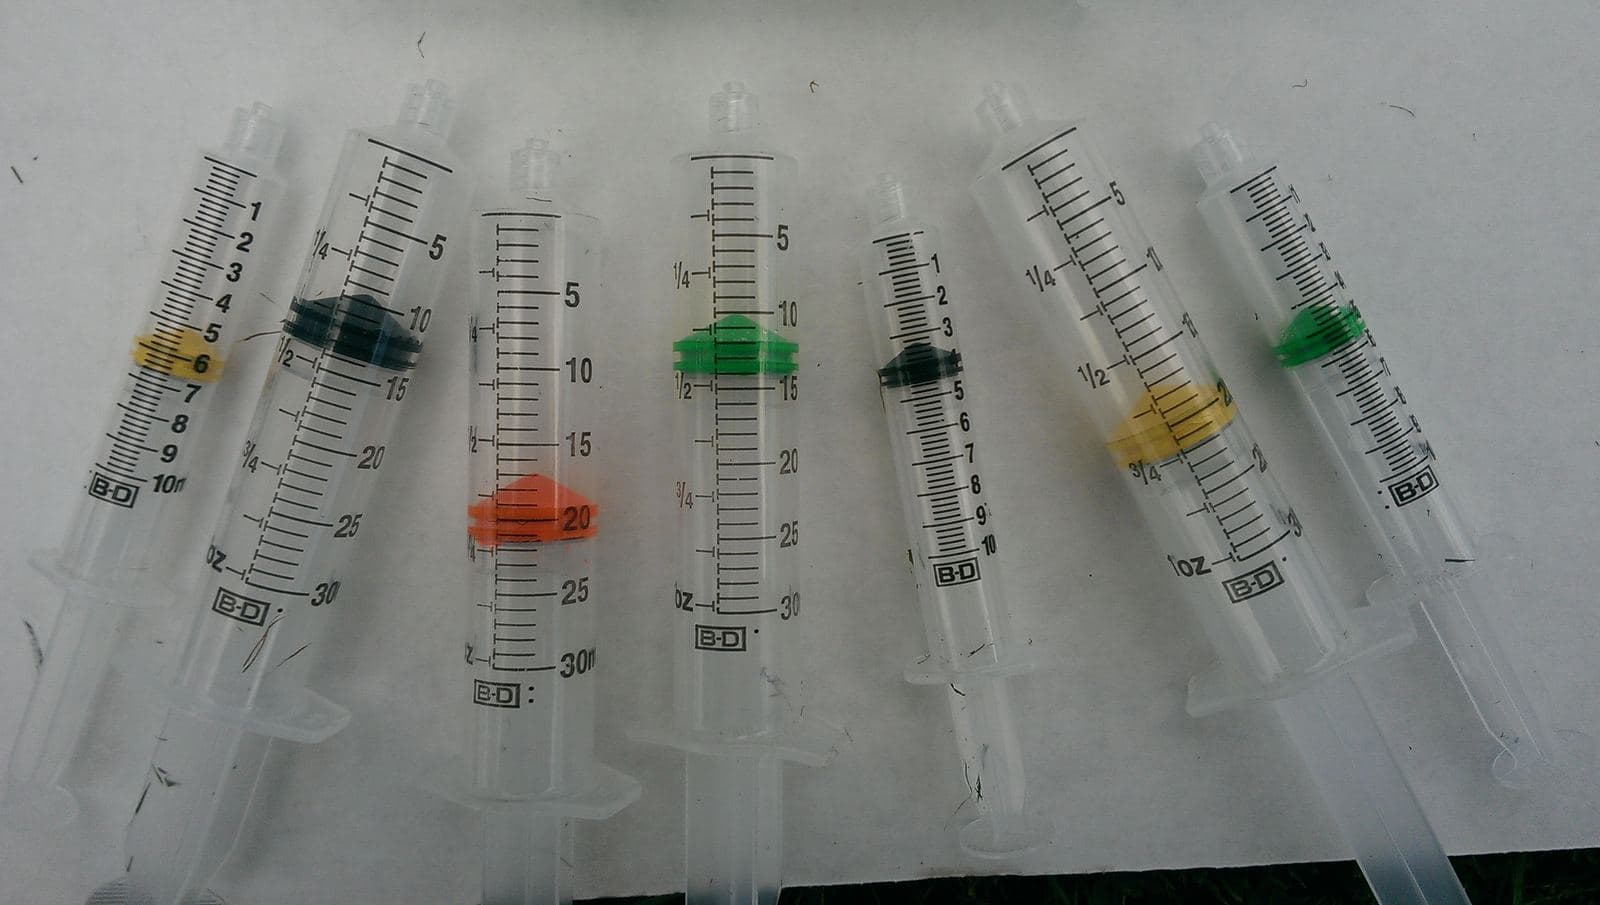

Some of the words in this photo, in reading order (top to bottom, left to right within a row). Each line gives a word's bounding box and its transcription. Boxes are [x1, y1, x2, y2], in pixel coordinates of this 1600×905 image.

[1109, 180, 1126, 206] 5
[250, 201, 262, 221] 1
[235, 231, 254, 252] 2
[428, 234, 447, 260] 5
[776, 224, 789, 251] 5
[226, 262, 243, 282] 3
[673, 261, 690, 290] 1/4
[931, 253, 940, 273] 1
[1025, 265, 1057, 292] 1/4
[215, 294, 232, 313] 4
[564, 281, 581, 308] 5
[937, 285, 948, 305] 2
[409, 305, 432, 333] 10
[778, 300, 798, 327] 10
[203, 323, 222, 343] 5
[942, 317, 953, 337] 3
[193, 354, 210, 374] 6
[565, 357, 593, 384] 10
[1077, 362, 1110, 389] 1/2
[184, 383, 202, 403] 7
[386, 376, 410, 401] 15
[675, 371, 692, 399] 1/2
[779, 375, 799, 401] 15
[954, 380, 965, 401] 5
[171, 414, 189, 434] 8
[959, 412, 970, 432] 6
[160, 444, 178, 463] 9
[565, 431, 592, 457] 15
[964, 442, 975, 464] 7
[357, 445, 386, 470] 20
[779, 448, 799, 475] 20
[971, 474, 981, 495] 8
[1129, 460, 1162, 485] 3/4
[91, 476, 133, 503] B-D
[675, 481, 694, 510] 3/4
[1394, 471, 1435, 502] B-D
[333, 513, 363, 538] 25
[562, 504, 591, 531] 20
[976, 505, 987, 526] 9
[780, 520, 799, 548] 25
[981, 534, 997, 556] 10
[937, 561, 976, 584] B-D
[1229, 568, 1276, 598] B-D
[311, 580, 341, 607] 30
[561, 576, 589, 606] 25
[217, 593, 262, 620] B-D
[780, 591, 800, 621] 30
[699, 629, 741, 649] B-D
[476, 684, 515, 705] B-D
